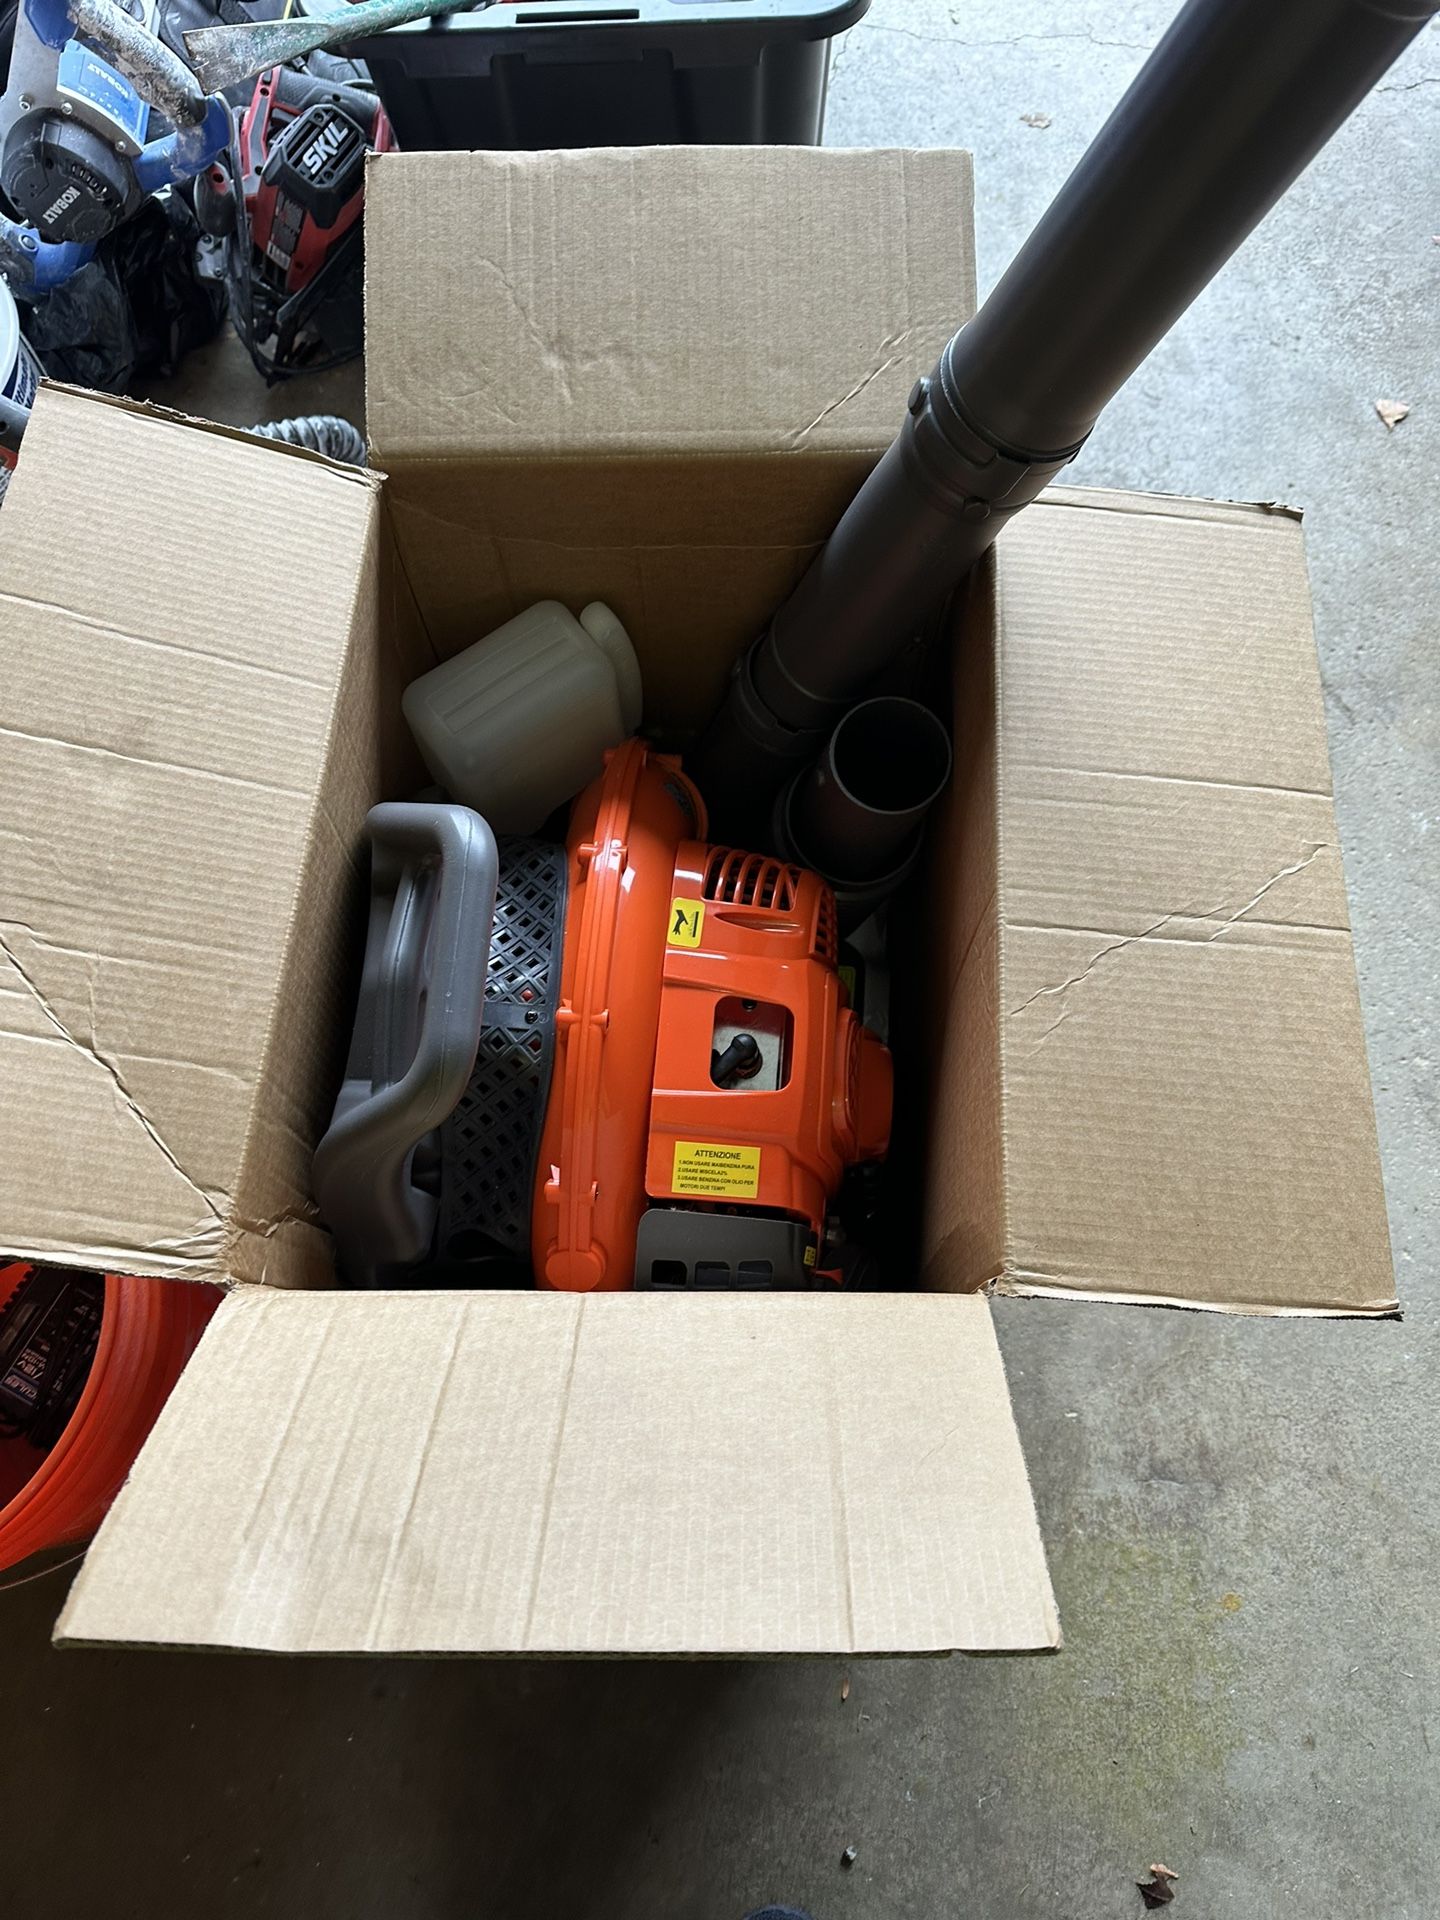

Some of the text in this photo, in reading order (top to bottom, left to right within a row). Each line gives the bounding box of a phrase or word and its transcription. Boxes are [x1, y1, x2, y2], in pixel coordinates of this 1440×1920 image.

[302, 122, 349, 175] SKIL
[42, 186, 81, 225] KOBALT
[695, 1149, 742, 1160] ATTENZIONE
